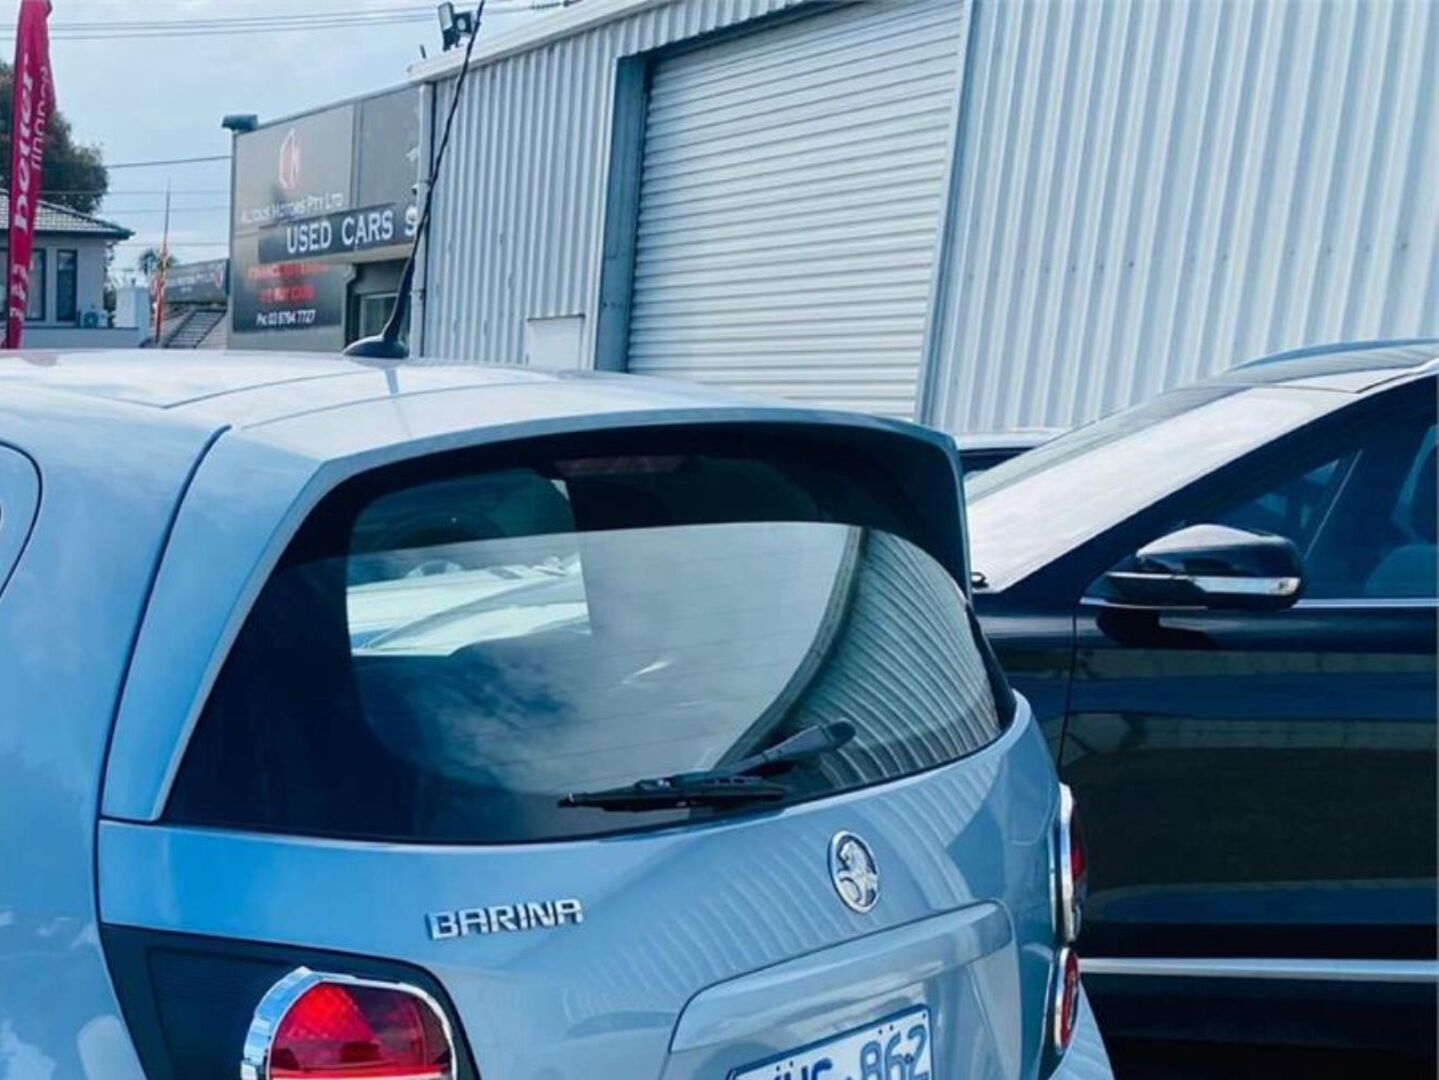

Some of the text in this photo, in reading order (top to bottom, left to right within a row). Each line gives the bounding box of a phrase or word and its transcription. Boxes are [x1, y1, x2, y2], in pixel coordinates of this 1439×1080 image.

[286, 220, 332, 253] USED
[342, 209, 394, 245] CARS
[428, 898, 584, 940] BARINA
